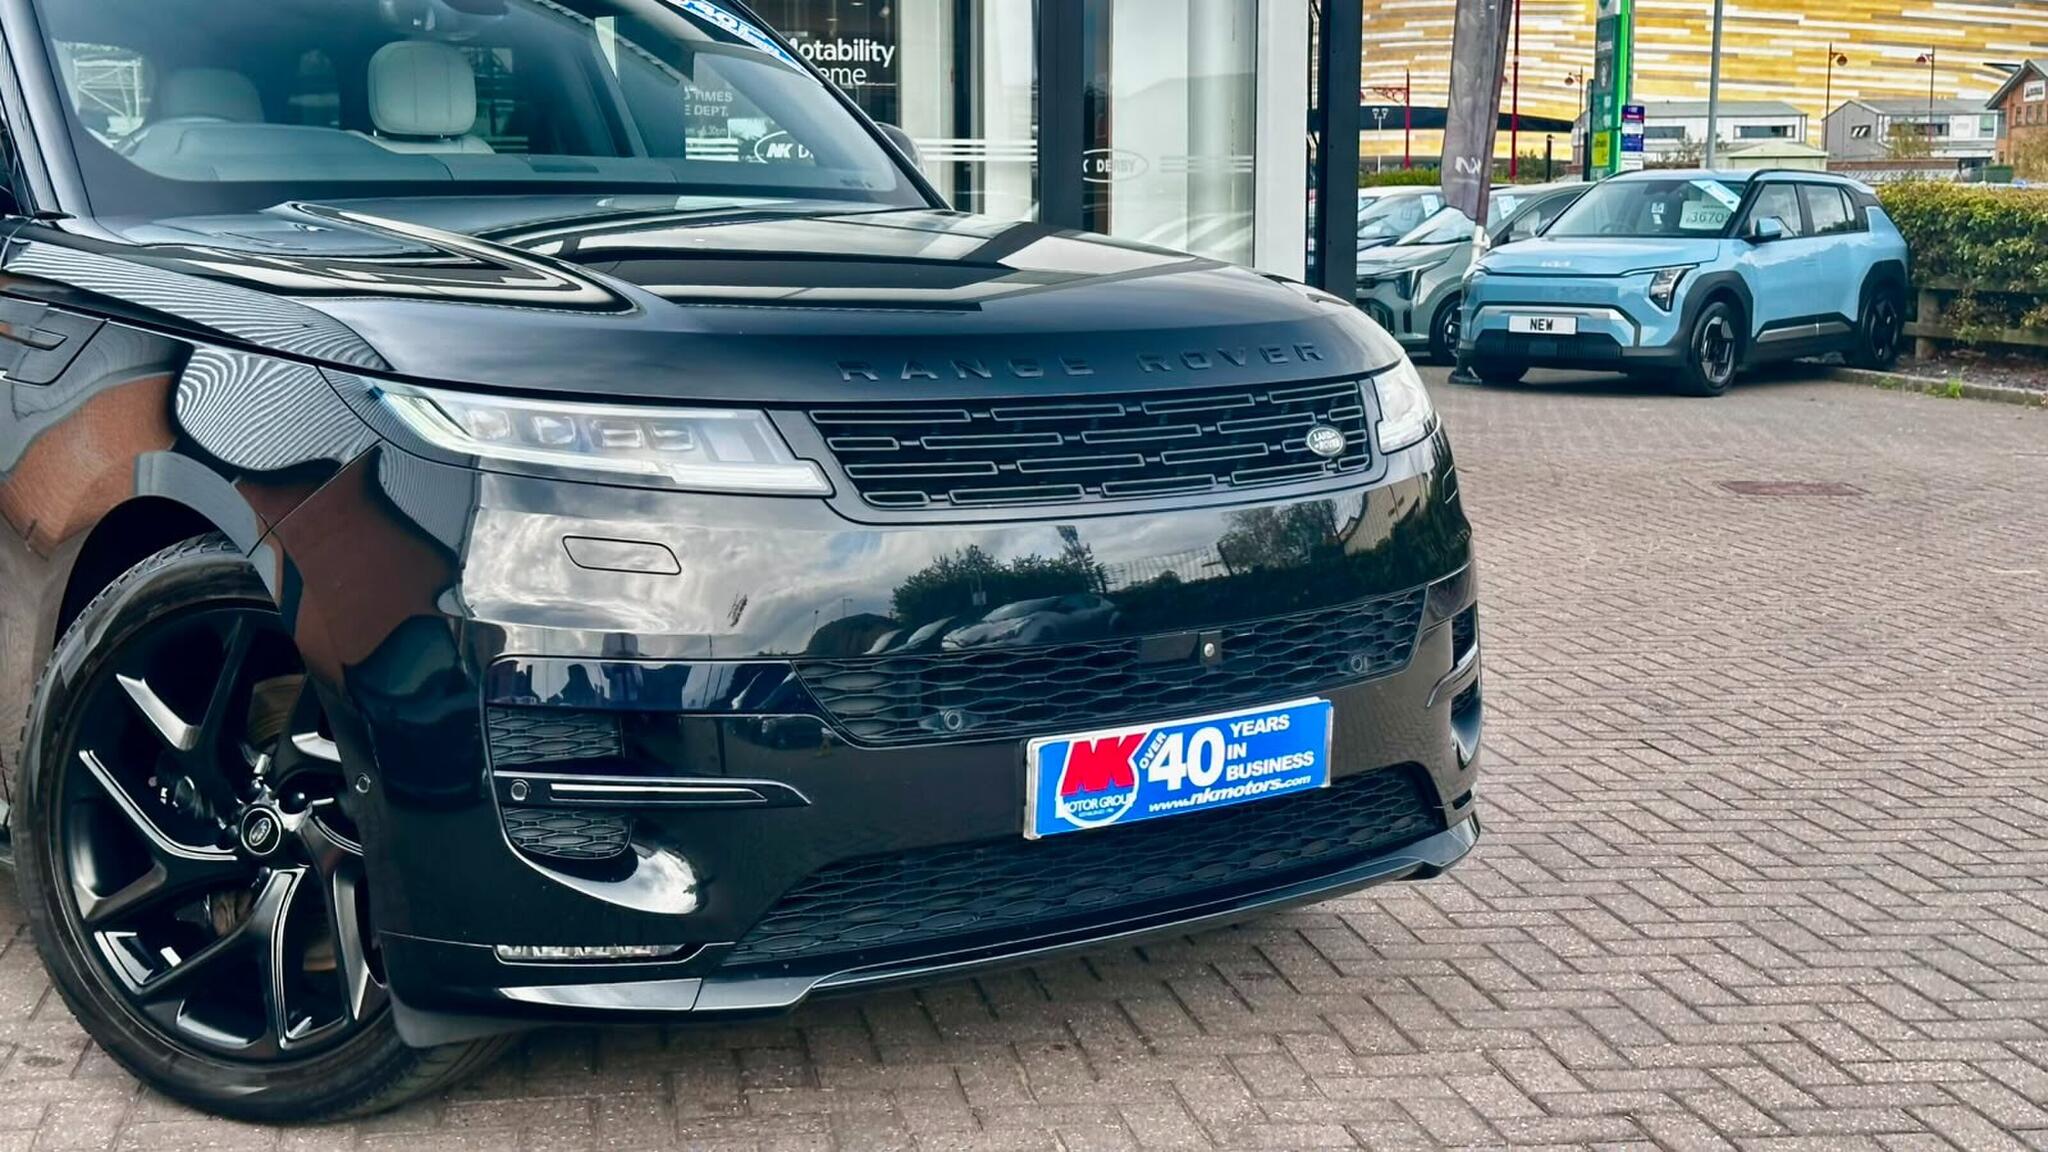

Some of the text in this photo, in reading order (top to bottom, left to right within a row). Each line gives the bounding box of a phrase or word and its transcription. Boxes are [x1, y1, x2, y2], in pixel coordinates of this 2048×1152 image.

[693, 105, 729, 117] DEPT.
[1529, 318, 1554, 331] NEW
[835, 343, 1324, 381] RANGE ROVER
[1229, 714, 1291, 738] YEARS
[1139, 726, 1226, 791] OVER 40
[1227, 742, 1248, 760] IN
[1226, 751, 1315, 782] BUSINESS
[1149, 775, 1312, 813] www.nkmotors.com
